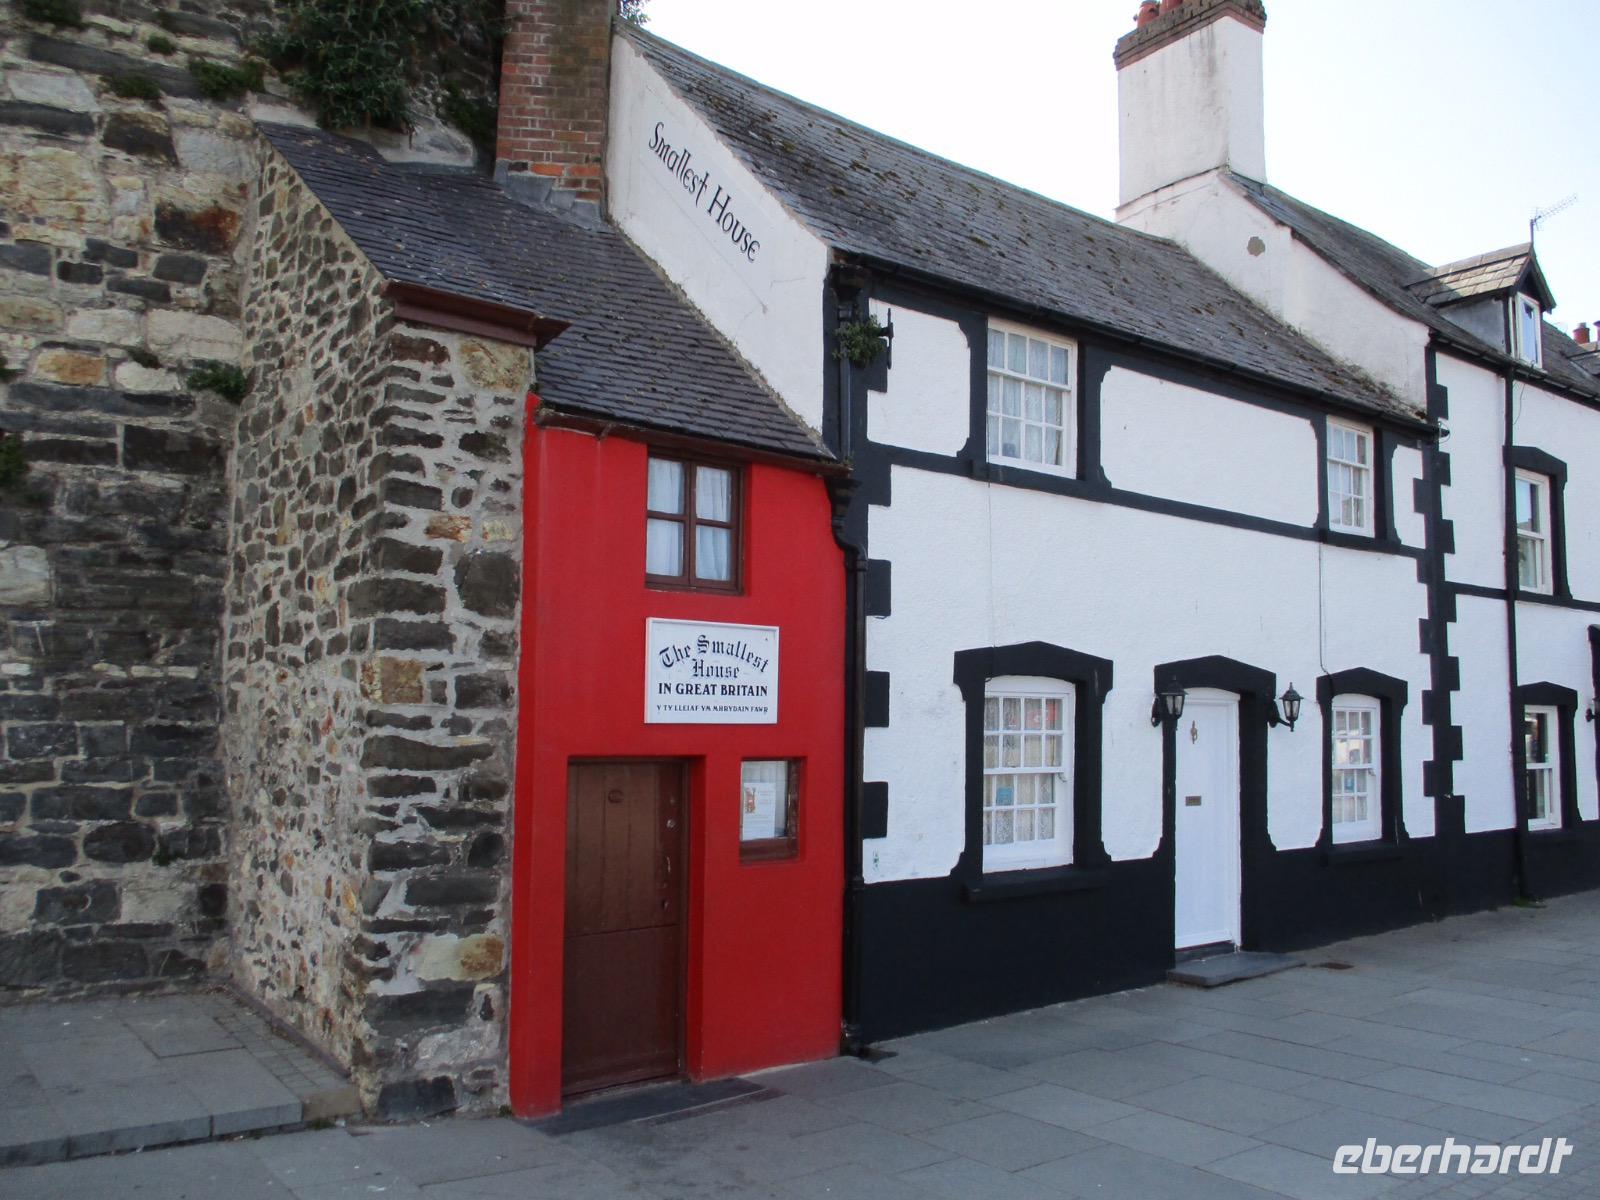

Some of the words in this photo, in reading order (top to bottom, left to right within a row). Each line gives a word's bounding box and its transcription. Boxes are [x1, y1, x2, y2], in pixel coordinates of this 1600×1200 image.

[649, 122, 709, 207] Smallest
[707, 185, 761, 261] House
[659, 645, 691, 668] The
[697, 634, 768, 673] Smallest
[692, 659, 739, 678] House
[658, 682, 672, 694] IN
[675, 683, 717, 695] GREAT
[720, 684, 768, 696] BRITAIN
